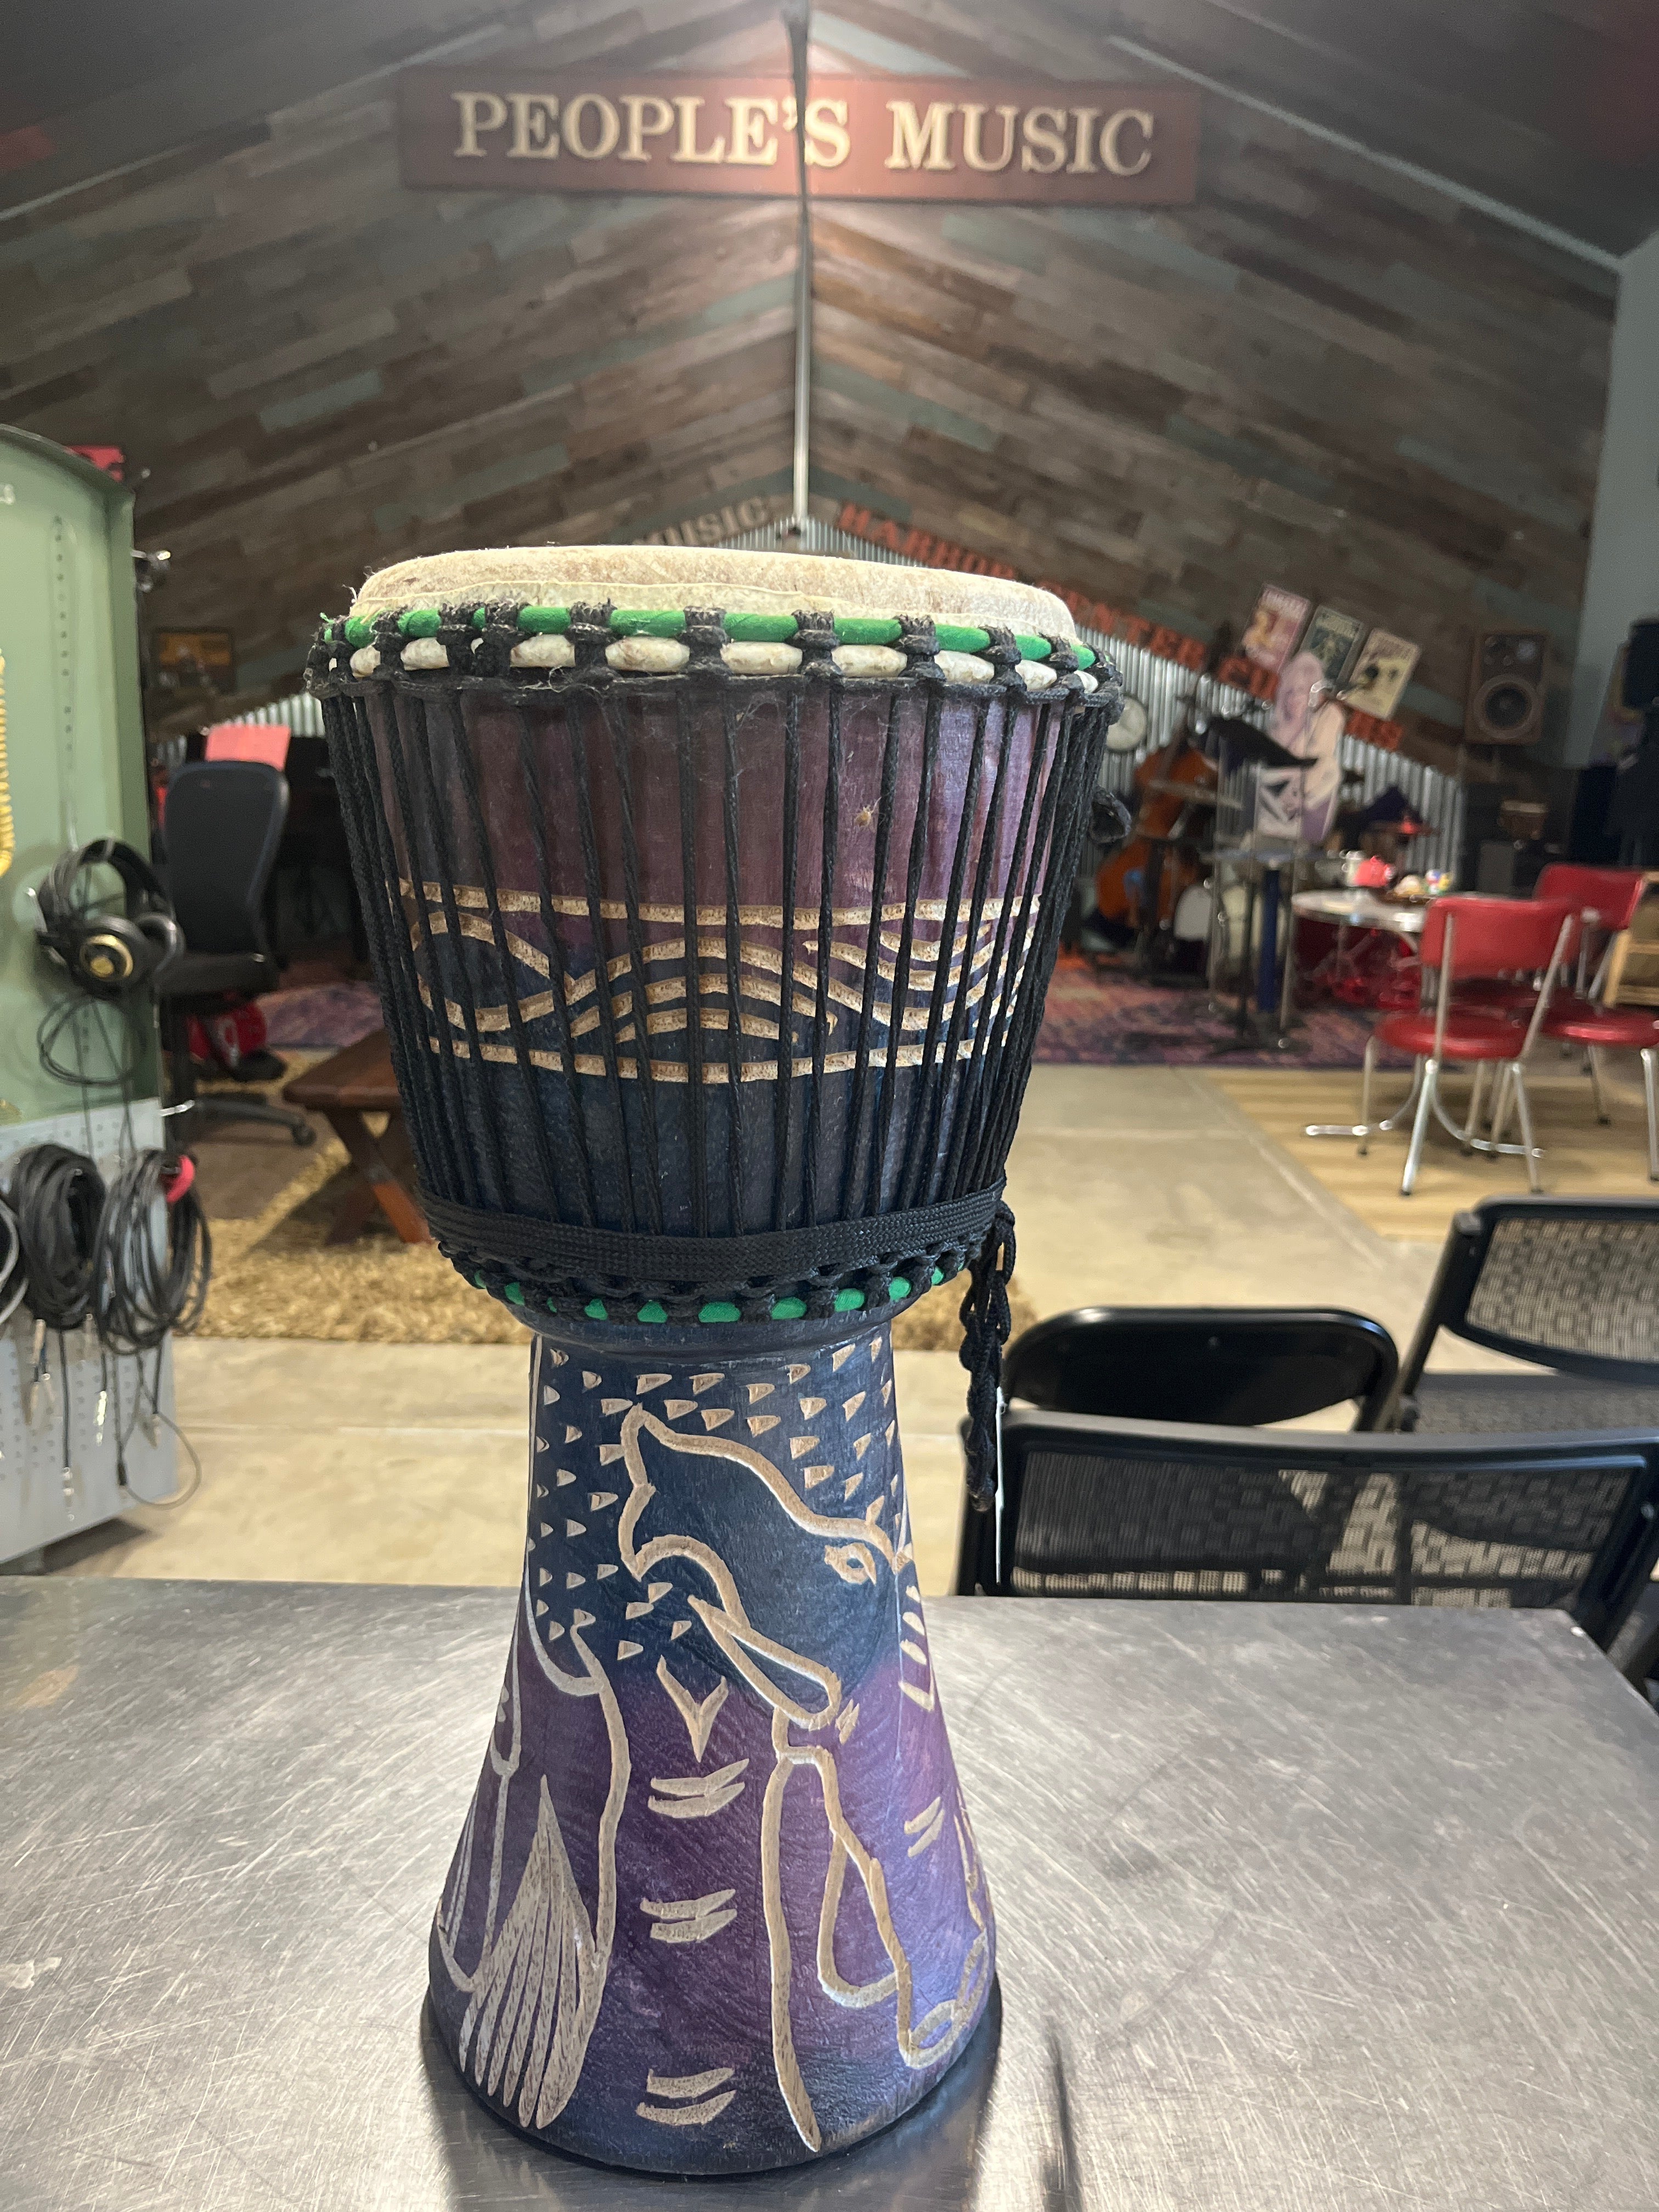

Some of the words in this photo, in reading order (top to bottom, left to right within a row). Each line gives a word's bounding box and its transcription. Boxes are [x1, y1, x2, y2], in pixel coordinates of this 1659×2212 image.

[452, 90, 850, 168] PEOPLE'S
[884, 100, 1153, 176] MUSIC
[632, 496, 768, 546] USIC
[1036, 578, 1206, 673] ENTER
